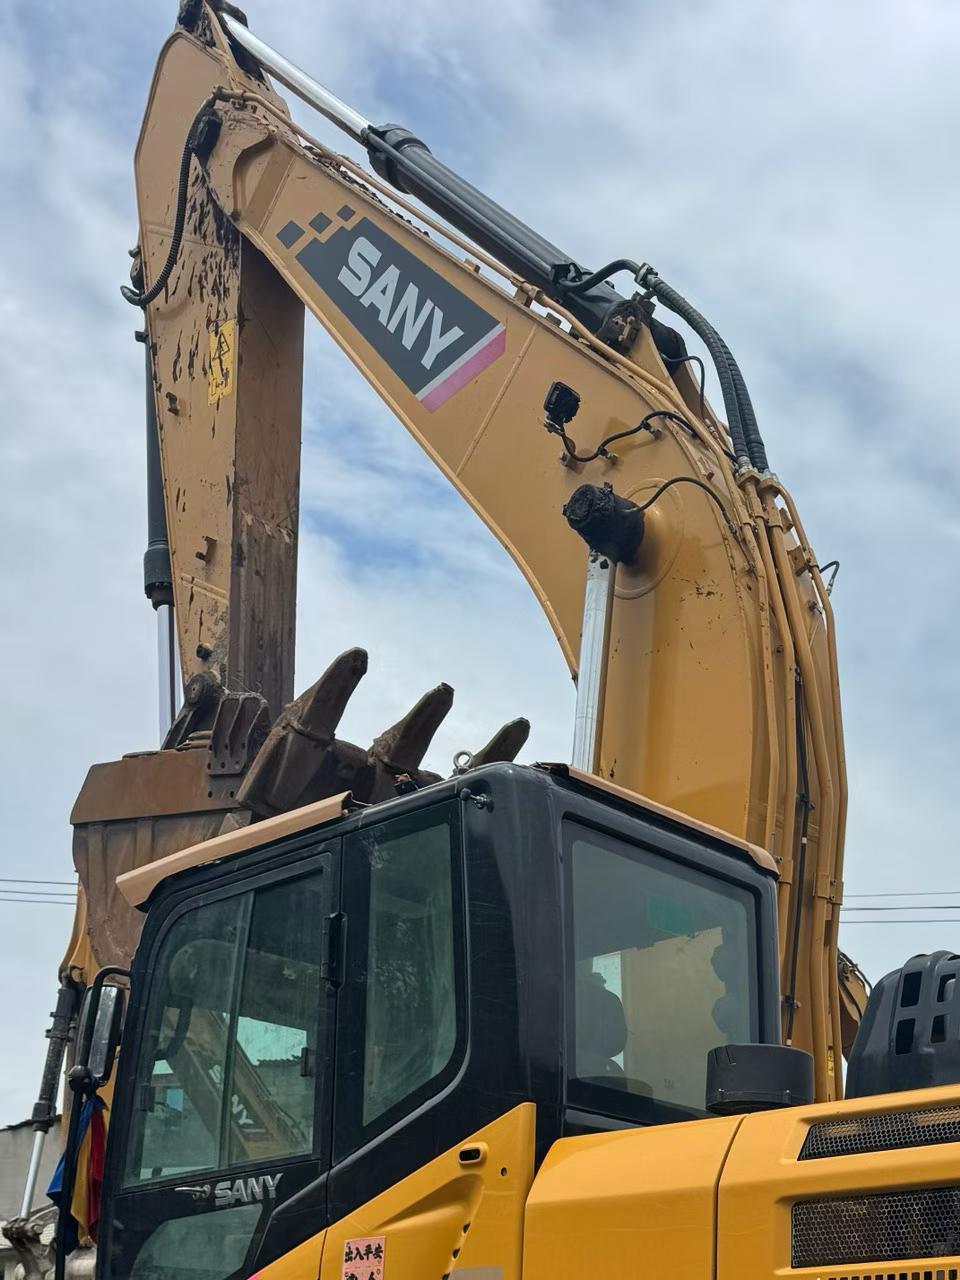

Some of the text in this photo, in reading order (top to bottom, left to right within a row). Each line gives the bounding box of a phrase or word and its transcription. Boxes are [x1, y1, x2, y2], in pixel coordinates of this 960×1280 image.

[337, 236, 465, 371] SANY
[208, 1064, 255, 1126] SNY
[214, 1173, 284, 1206] SANY
[344, 1243, 384, 1262] 出入平安
